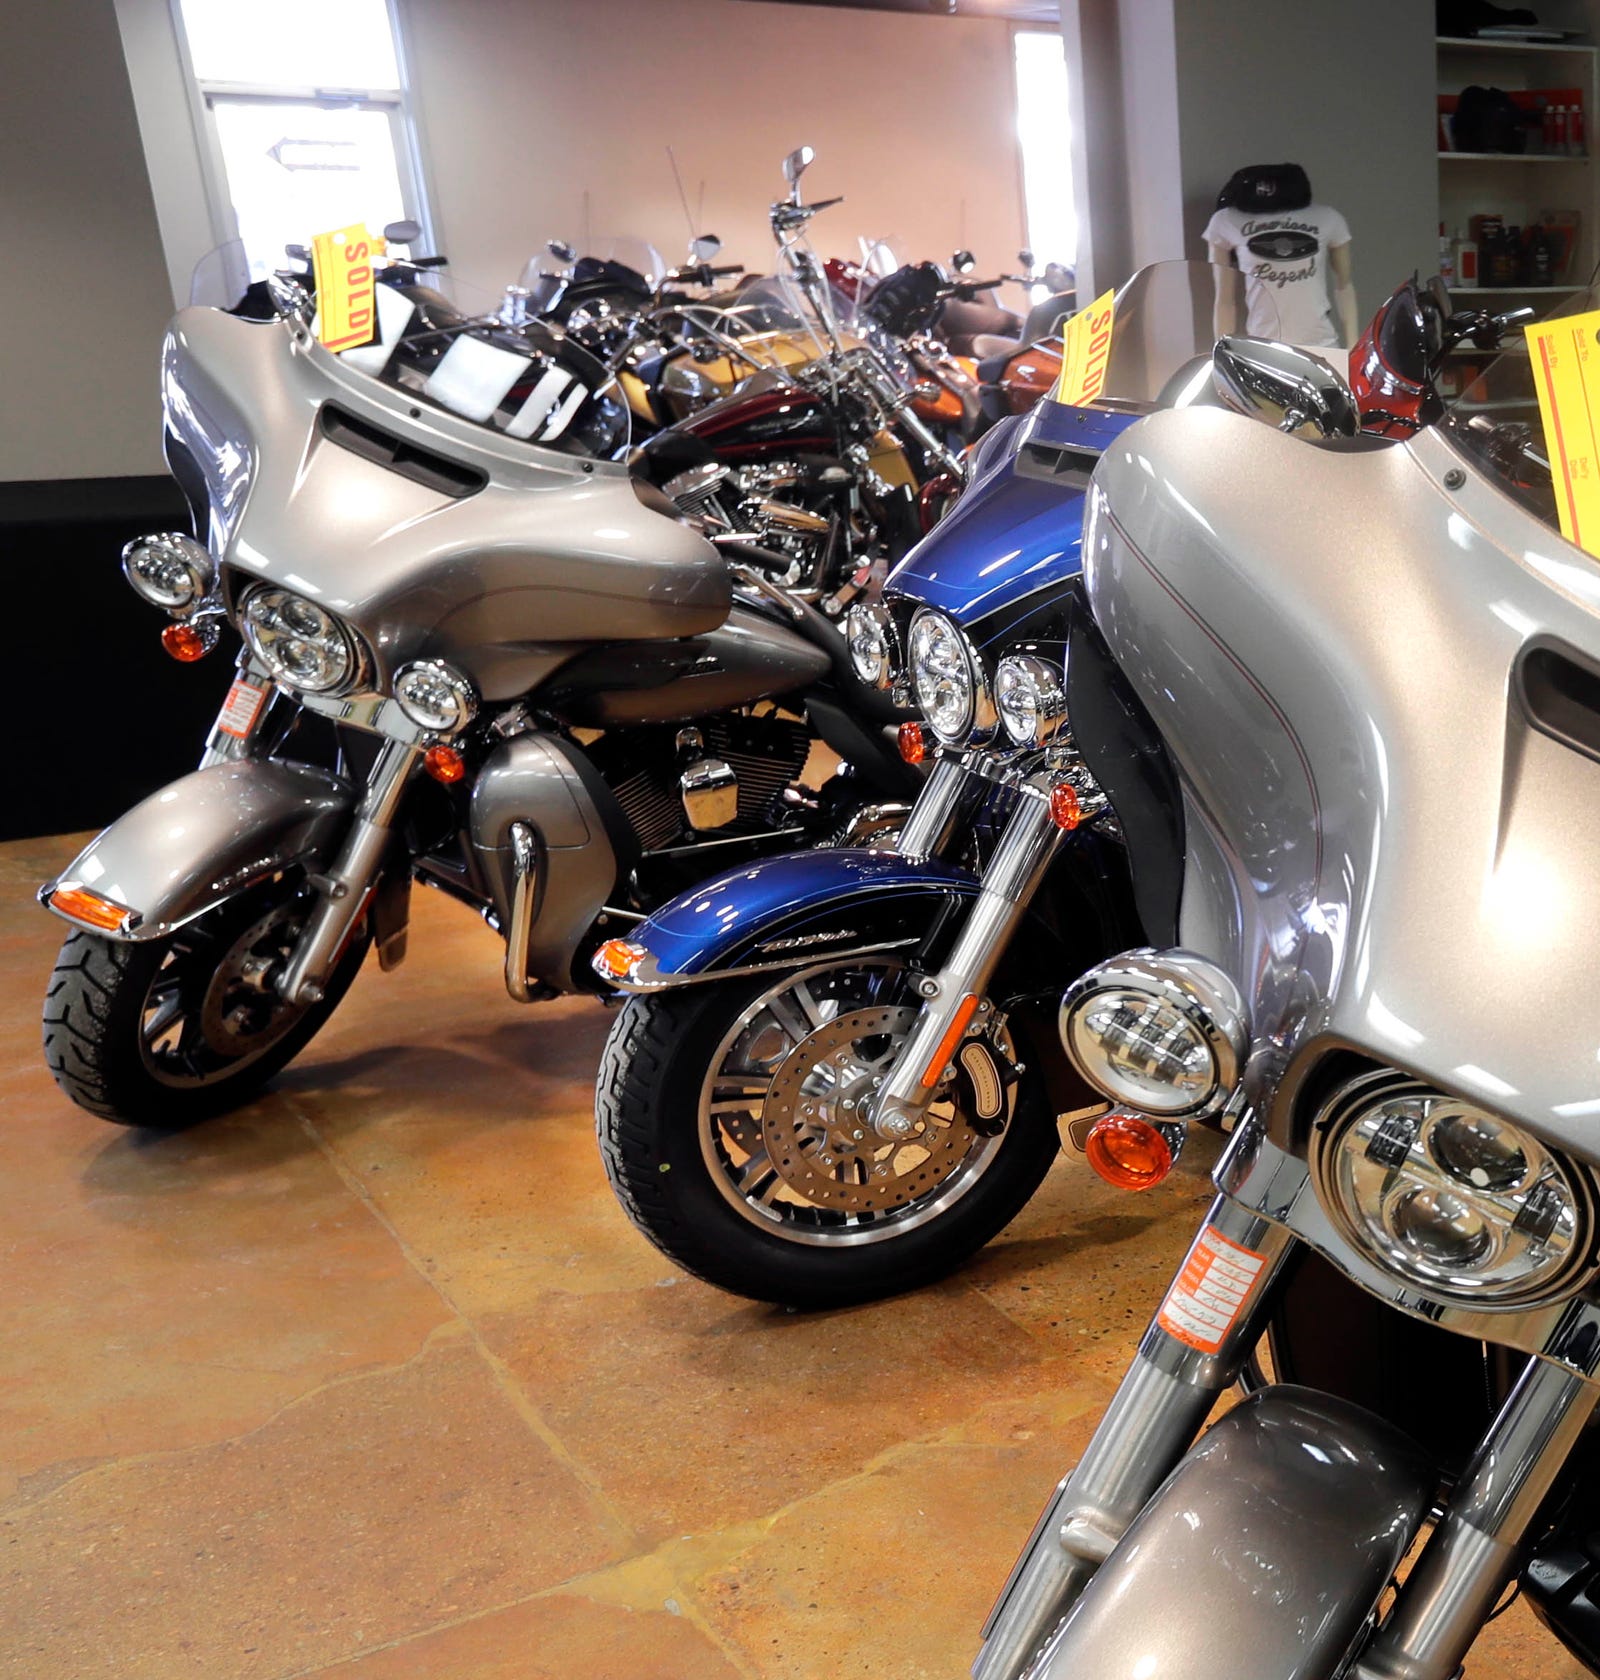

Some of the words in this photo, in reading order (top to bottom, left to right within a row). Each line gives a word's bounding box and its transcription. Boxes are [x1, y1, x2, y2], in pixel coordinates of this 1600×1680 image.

[1241, 217, 1319, 237] American
[344, 242, 370, 330] SOLD
[1253, 257, 1318, 288] Legend
[1082, 309, 1112, 392] SOLD
